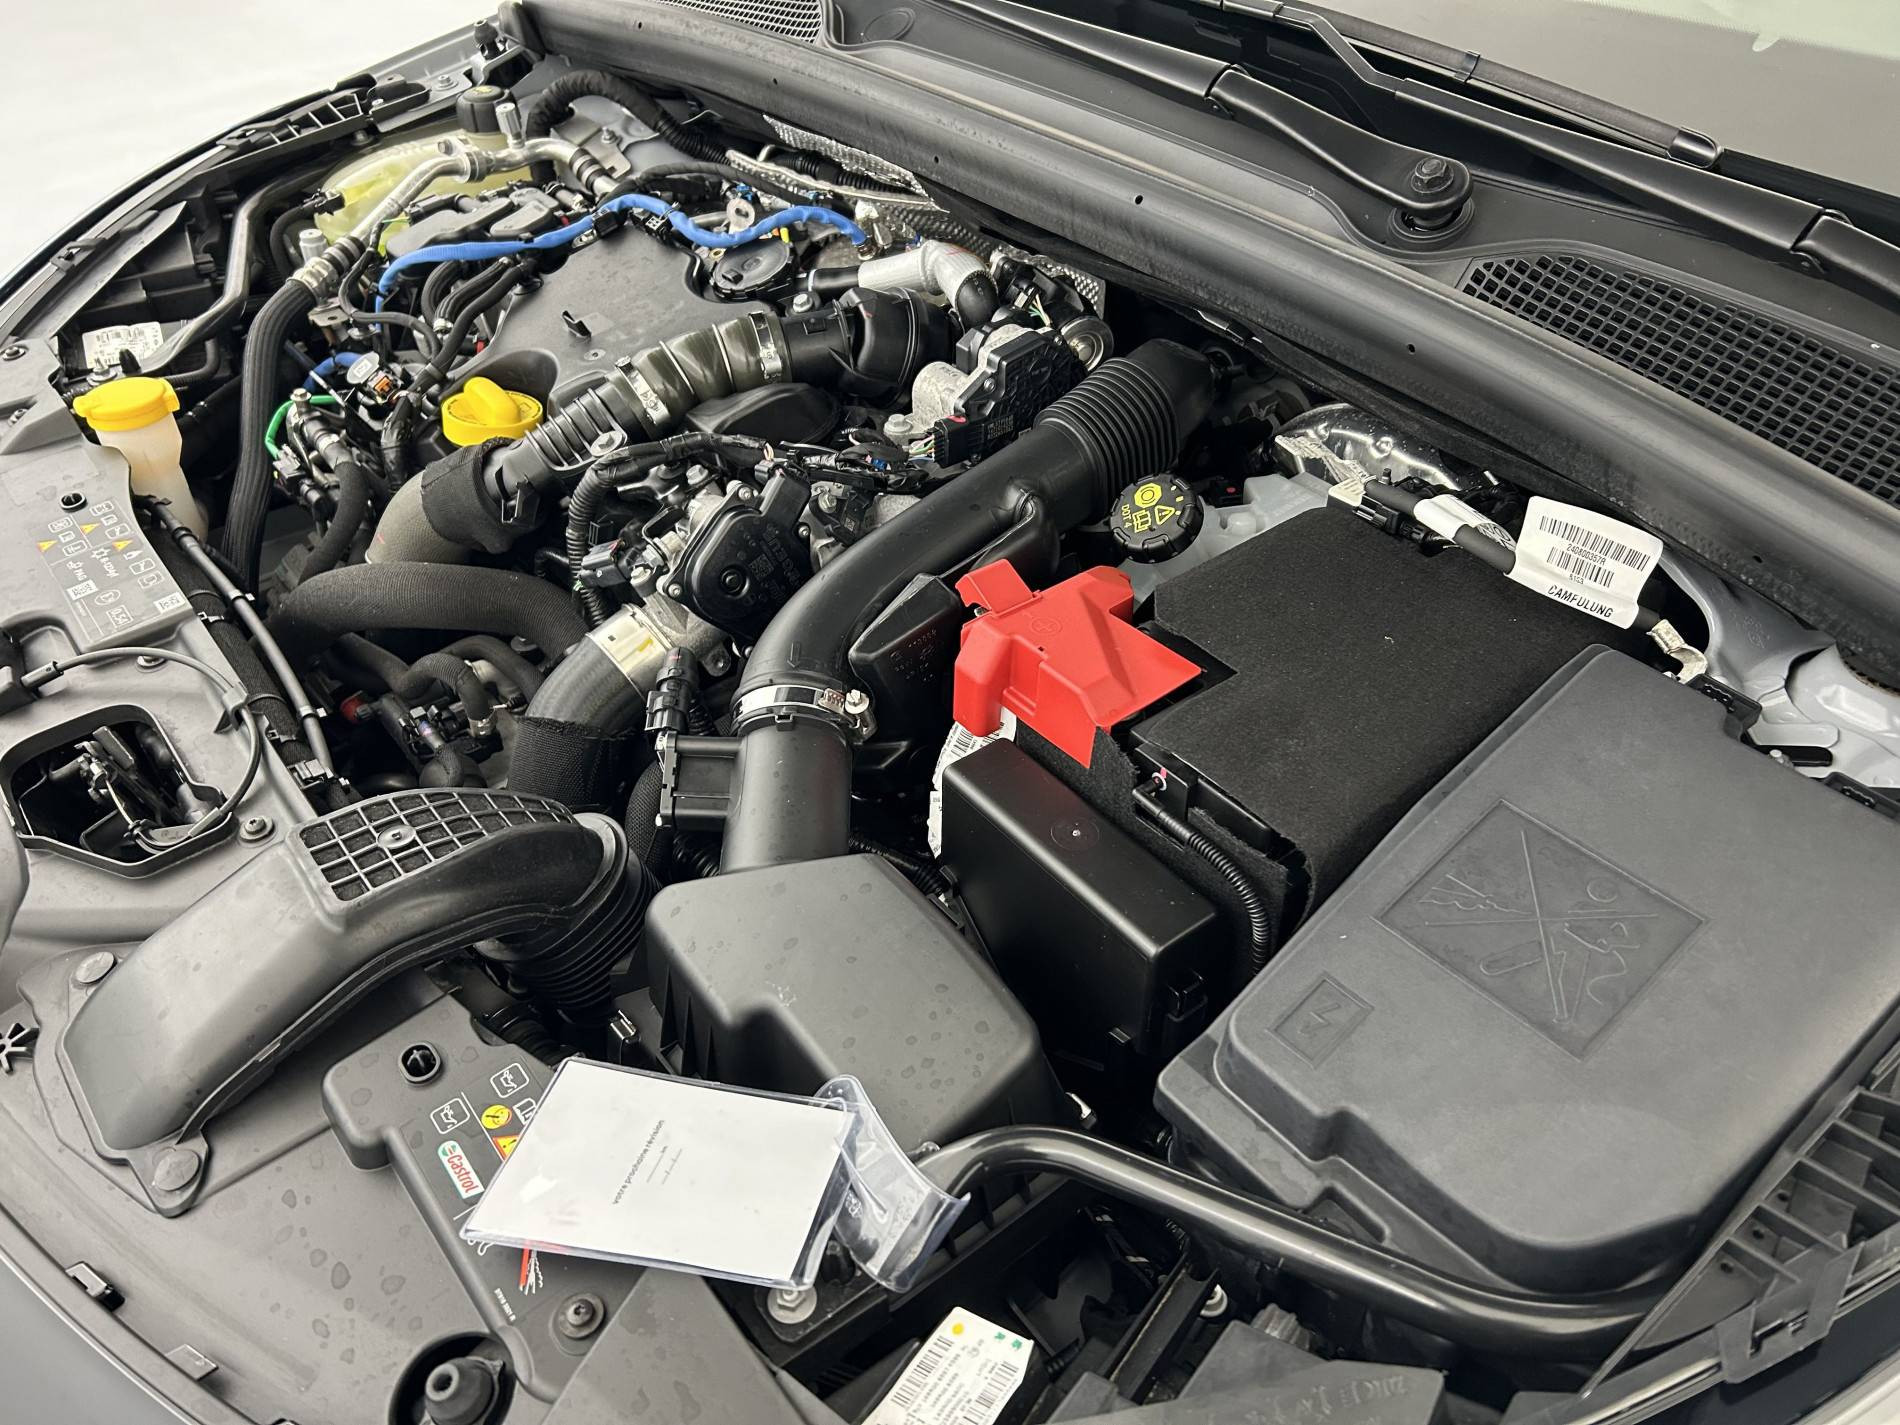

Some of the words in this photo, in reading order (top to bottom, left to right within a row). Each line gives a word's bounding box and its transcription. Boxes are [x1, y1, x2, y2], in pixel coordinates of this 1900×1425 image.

[1121, 504, 1131, 520] DOT
[1547, 584, 1614, 618] CAMFULUNG
[446, 1152, 479, 1193] Castrol
